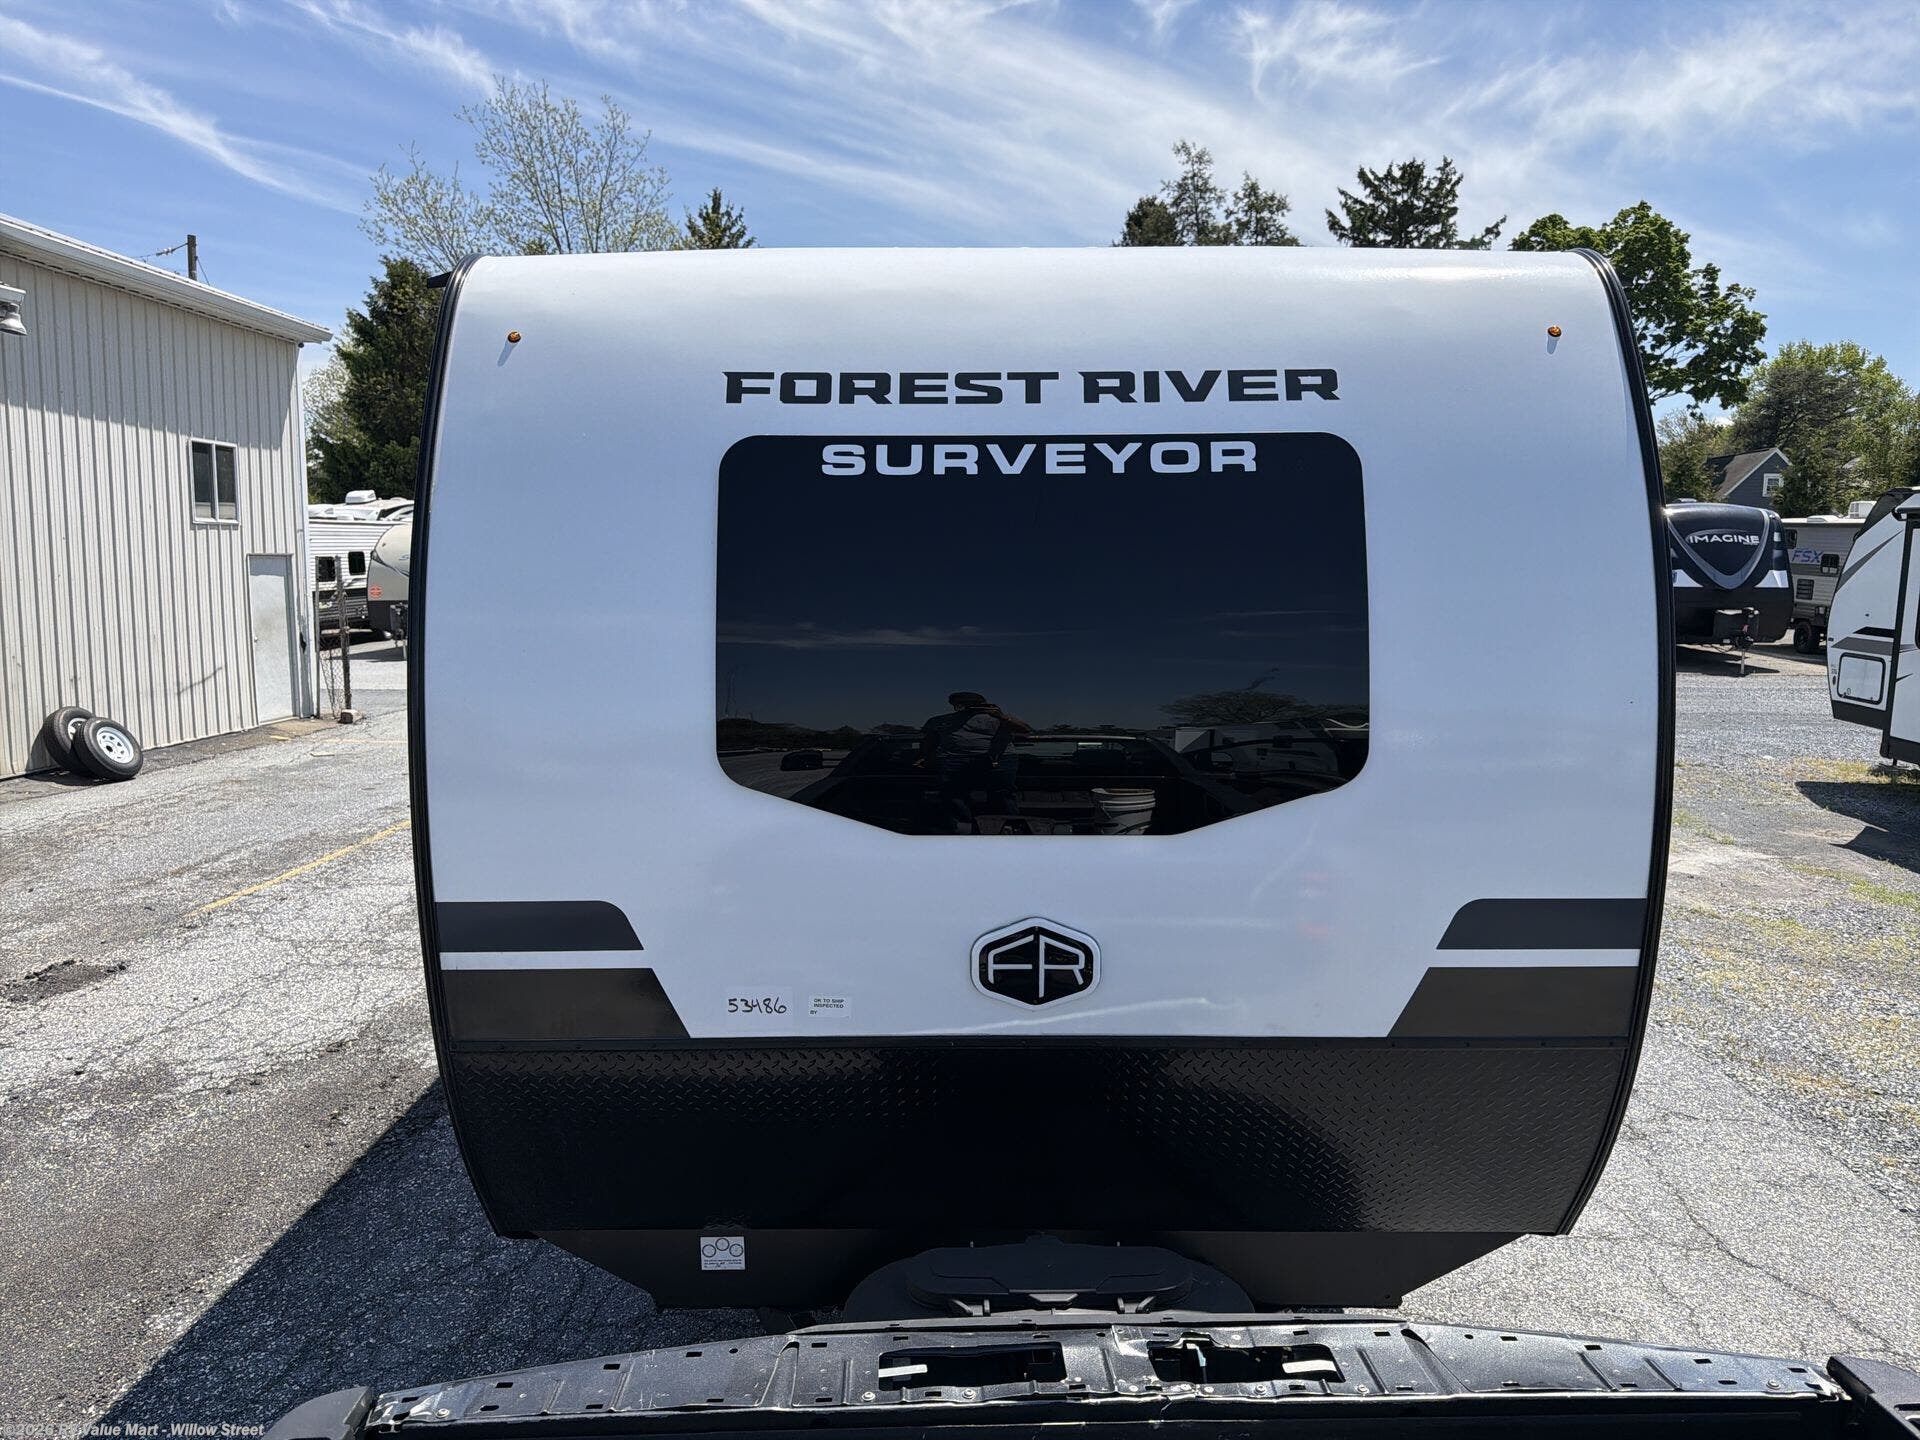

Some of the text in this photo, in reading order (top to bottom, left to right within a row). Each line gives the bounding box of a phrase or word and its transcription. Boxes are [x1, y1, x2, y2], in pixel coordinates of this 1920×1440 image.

[722, 369, 1340, 405] FOREST RIVER
[821, 441, 1257, 477] SURVEYOR
[1689, 534, 1760, 545] IMAGINE
[1791, 549, 1824, 563] FSX
[727, 996, 788, 1014] 53486
